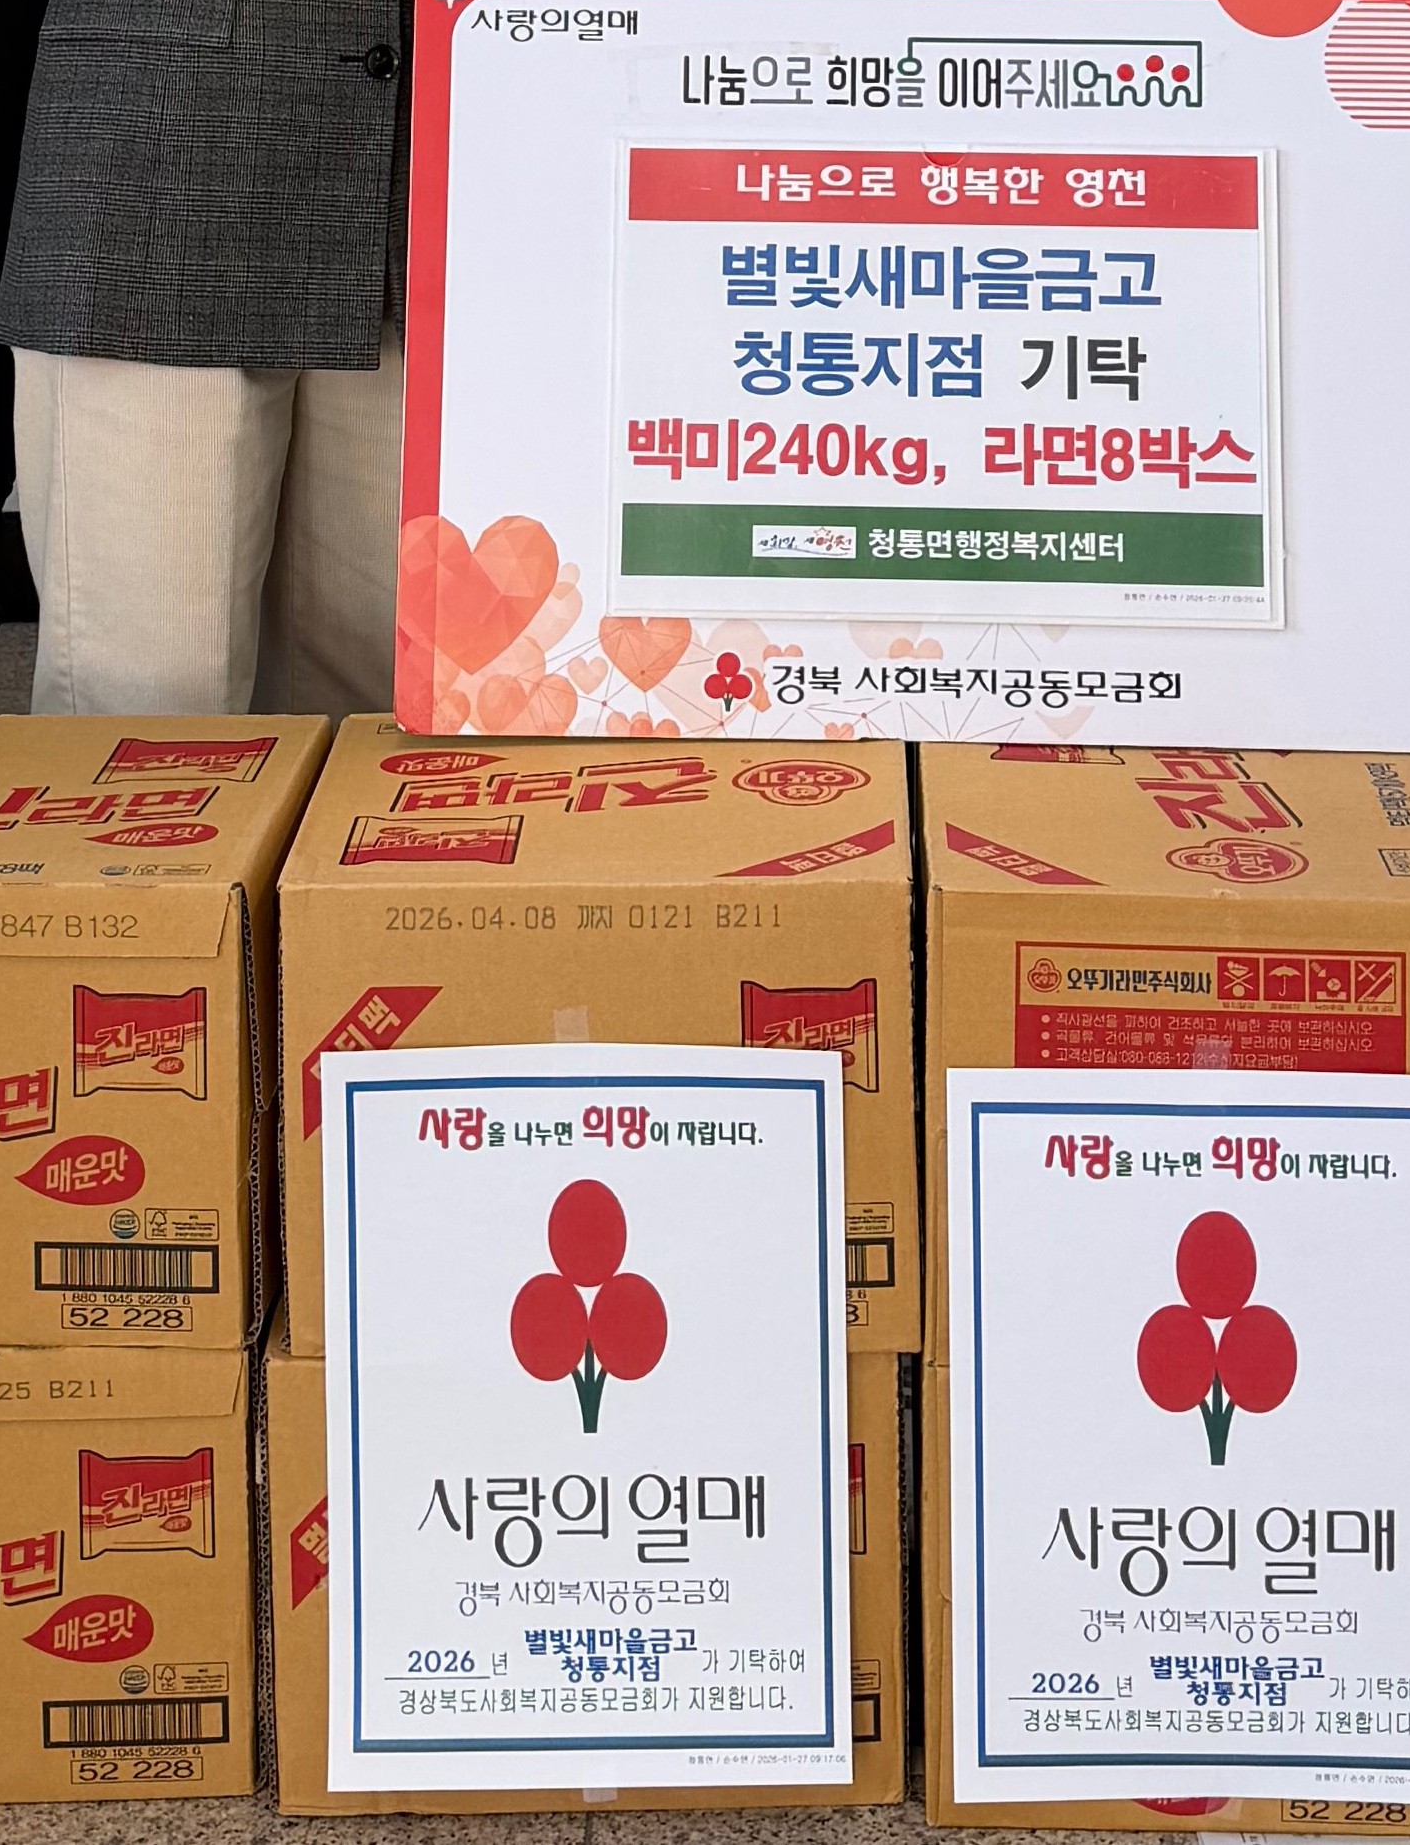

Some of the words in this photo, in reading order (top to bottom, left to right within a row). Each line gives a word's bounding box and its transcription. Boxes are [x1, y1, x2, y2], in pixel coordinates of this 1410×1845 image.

[470, 8, 639, 43] 사랑의열매
[683, 55, 814, 105] 나눔으로
[827, 56, 925, 108] 희망을
[939, 56, 1102, 109] 이어주세요
[736, 164, 896, 202] 나눔으로
[921, 165, 1044, 206] 행복한
[1066, 167, 1146, 208] 영천
[721, 243, 1162, 313] 별빛새마을금고
[733, 330, 983, 399] 청통지점
[1020, 335, 1148, 402] 기탁
[627, 417, 947, 486] 백미240kg,
[984, 422, 1258, 490] 라면8박스
[868, 528, 1124, 562] 청통면행정복지센터
[772, 665, 842, 704] 경북
[855, 665, 1183, 709] 사회복지공동모금회
[390, 758, 716, 812] 진라면
[65, 912, 139, 940] B132
[385, 906, 556, 932] 2026.04.08
[577, 906, 613, 930] 까지
[628, 905, 693, 930] 0121
[716, 904, 781, 929] B211
[1067, 968, 1211, 995] 오뚜기라면주식회사
[94, 1020, 185, 1066] 진라면
[418, 1106, 507, 1152] 사랑을
[514, 1121, 574, 1147] 나누면
[582, 1105, 670, 1150] 희망이
[677, 1120, 764, 1147] 자랍니다.
[45, 1146, 129, 1194] 매운맛
[1044, 1134, 1134, 1180] 사랑을
[1142, 1151, 1202, 1178] 나누면
[1211, 1135, 1301, 1182] 희망이
[1308, 1153, 1397, 1180] 자랍니다.
[70, 1308, 109, 1327] 52
[123, 1308, 184, 1328] 228
[50, 1381, 114, 1399] B211
[102, 1483, 193, 1528] 진라면
[417, 1474, 610, 1569] 사랑의
[628, 1473, 766, 1564] 열매
[1041, 1505, 1237, 1598] 사랑의
[1255, 1506, 1395, 1595] 열매
[455, 1581, 501, 1617] 경북
[508, 1577, 730, 1616] 사회복지공동모금회
[52, 1606, 136, 1652] 매운맛
[524, 1628, 697, 1655] 별빛새마을금고
[1080, 1609, 1126, 1643] 경북
[1133, 1607, 1358, 1645] 사회복지공동모금회
[407, 1649, 476, 1674] 2026
[491, 1651, 508, 1676] 년
[560, 1655, 662, 1683] 청통지점
[702, 1648, 719, 1675] 가
[728, 1648, 805, 1674] 기탁하여
[1149, 1655, 1326, 1681] 별빛새마을금고
[1031, 1672, 1100, 1695] 2026
[1116, 1675, 1133, 1698] 년
[1186, 1681, 1288, 1707] 청통지점
[1329, 1677, 1346, 1701] 가
[399, 1686, 679, 1716] 경상북도사회복지공동모금회가
[688, 1685, 794, 1711] 지원합니다.
[1023, 1708, 1306, 1734] 경상북도사회복지공동모금회가
[78, 1762, 110, 1780] 52
[133, 1761, 194, 1779] 228
[1289, 1799, 1329, 1819] 52
[1345, 1802, 1406, 1823] 228
